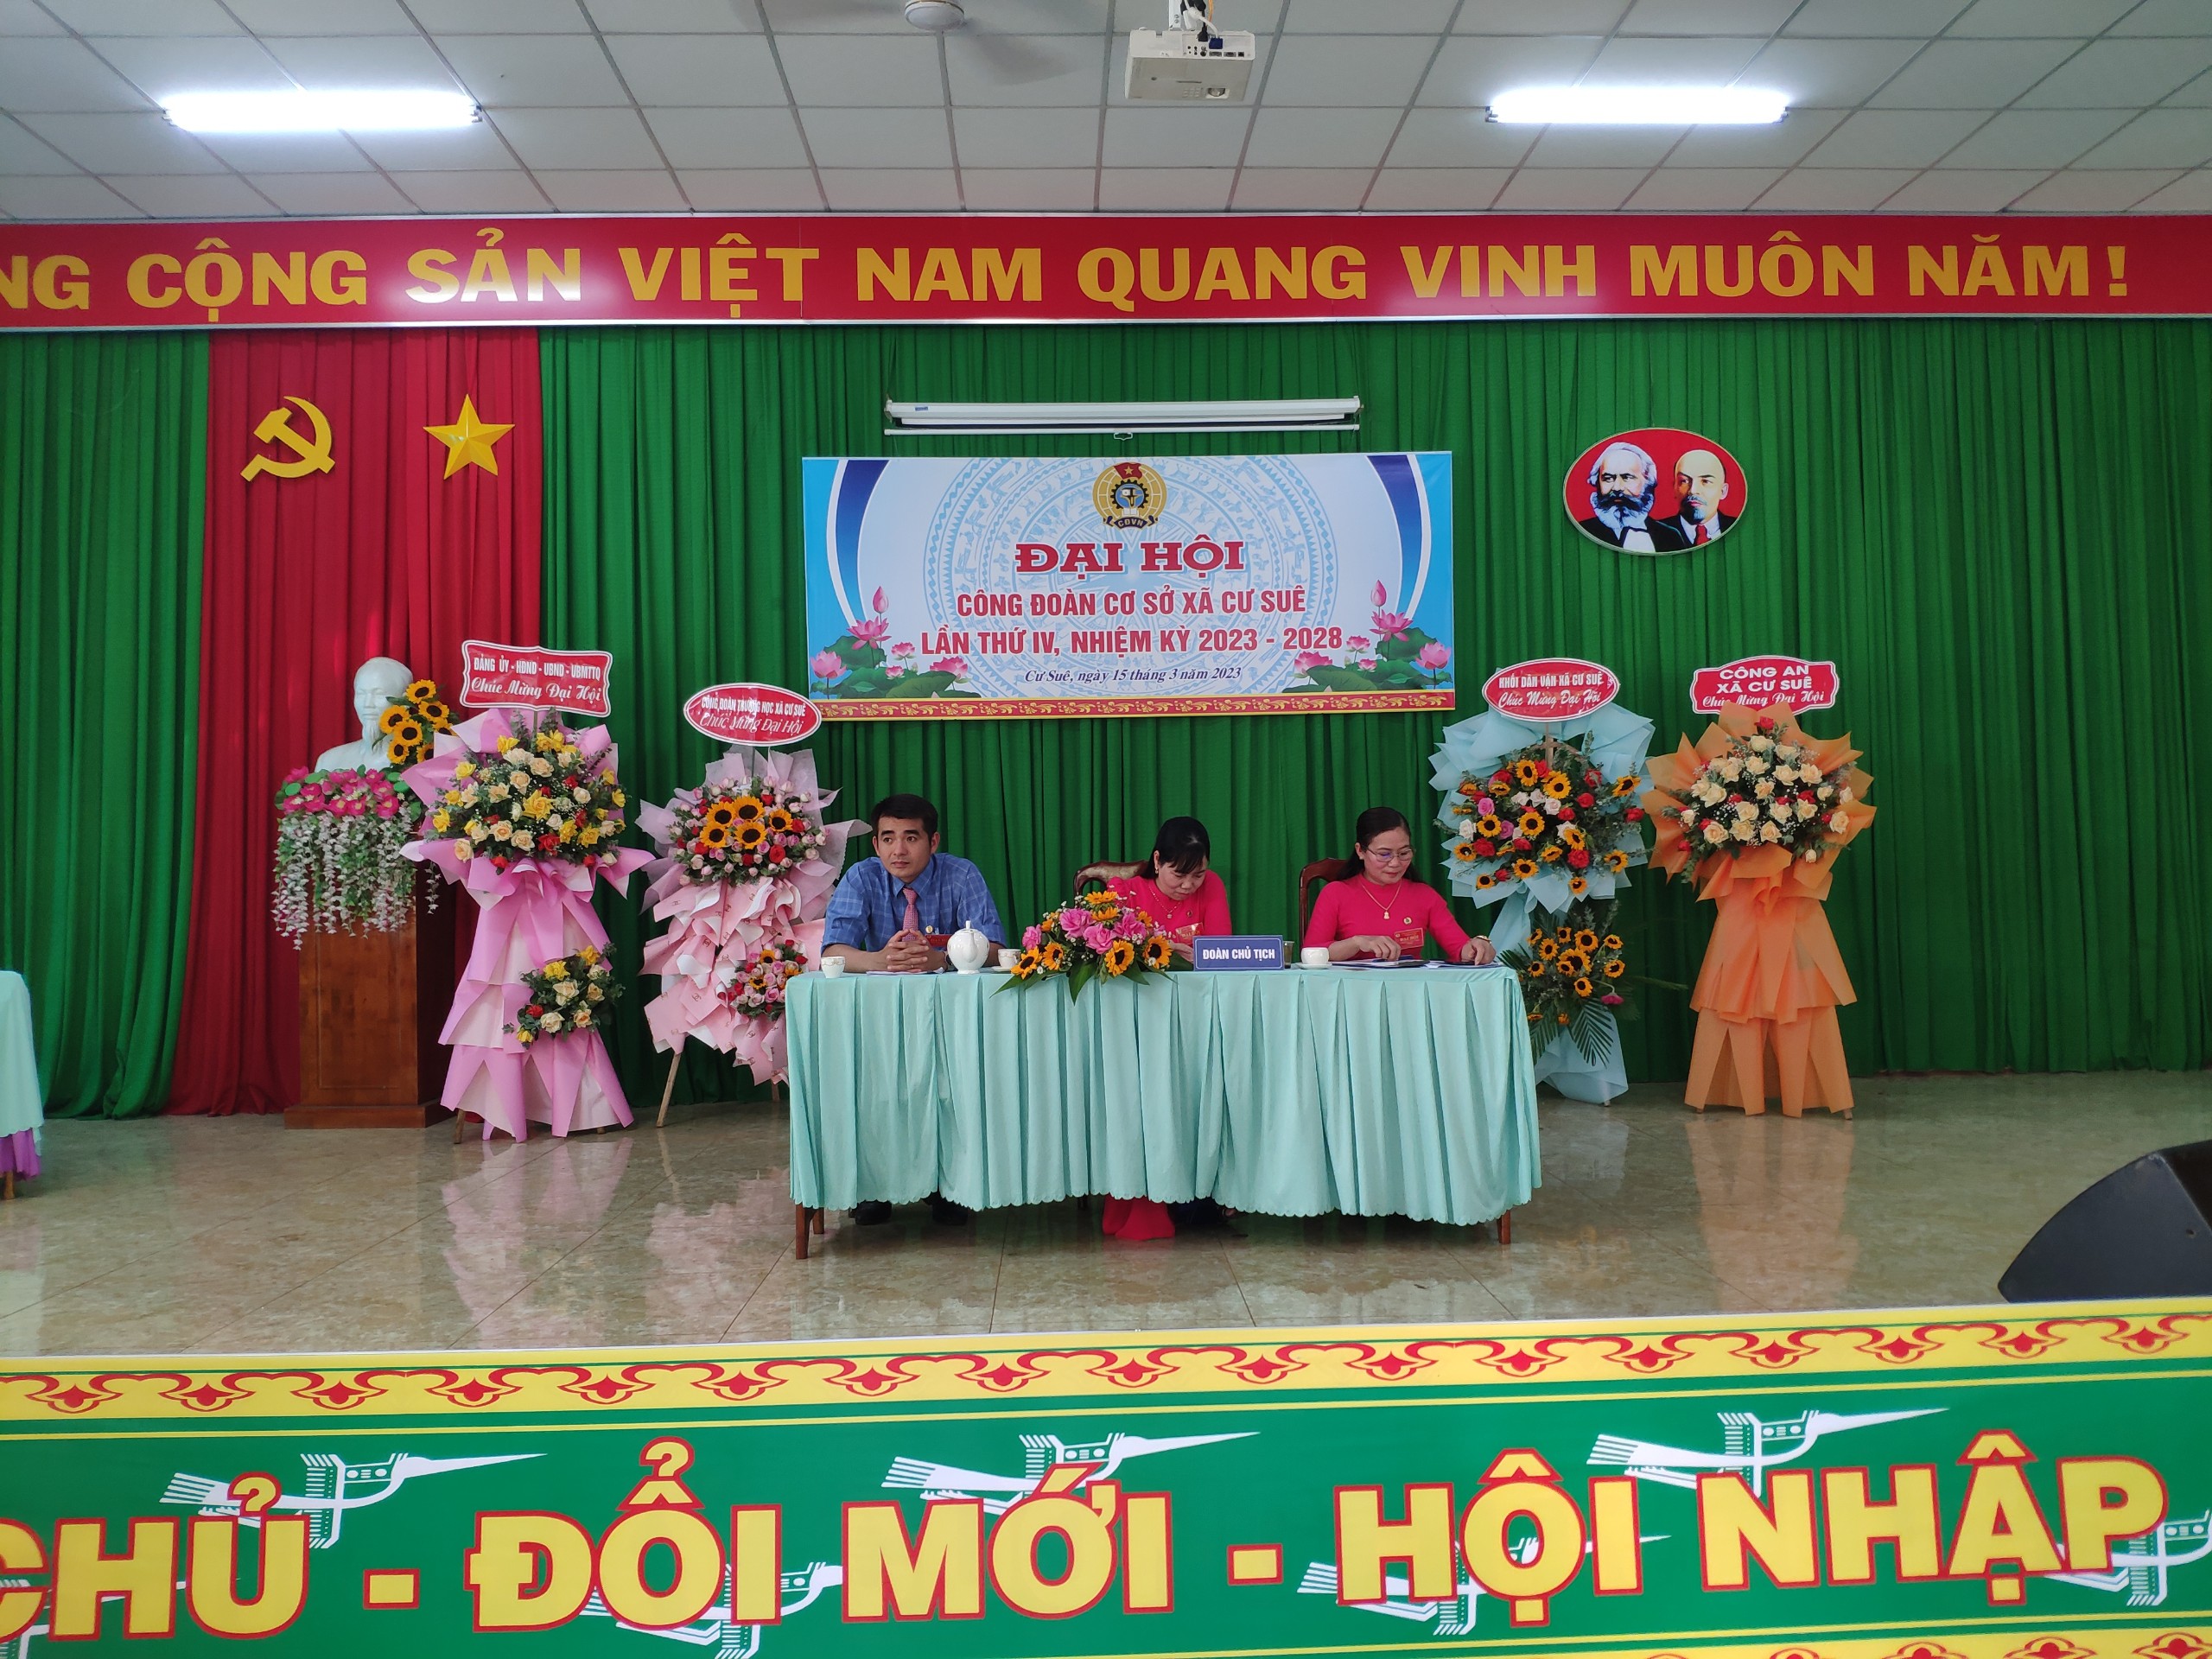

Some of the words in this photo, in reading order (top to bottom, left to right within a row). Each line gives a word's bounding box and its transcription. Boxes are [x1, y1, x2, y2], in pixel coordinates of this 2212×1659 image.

[127, 237, 367, 322] CỘNG
[404, 226, 582, 304] SẢN
[619, 232, 819, 318] VIỆT
[856, 247, 1042, 302] NAM
[1077, 245, 1366, 313] QUANG
[1401, 245, 1597, 298] VINH
[1630, 230, 1874, 297] MUÔN
[1908, 234, 2089, 296] NĂM
[1015, 543, 1123, 581] ĐẠI
[1141, 534, 1245, 578] HỘI
[957, 589, 1023, 617] CÔNG
[1030, 588, 1096, 616] ĐOÀN
[1103, 591, 1135, 615] CƠ
[1143, 585, 1174, 614] SỞ
[1183, 588, 1213, 614] XÃ
[1222, 589, 1255, 613] CƯ
[1261, 586, 1306, 613] SUÊ
[921, 625, 969, 655] LẦN
[977, 626, 1027, 654] THỨ
[1033, 631, 1060, 657] IV,
[1071, 626, 1152, 658] NHIỆM
[1160, 625, 1190, 652] KỲ
[1198, 629, 1258, 652] 2023
[1283, 626, 1343, 650] 2028
[474, 653, 496, 672] ĐẢNG
[499, 655, 510, 673] ỦY
[543, 663, 564, 677] UBND
[571, 664, 601, 681] UBMTTQ
[1025, 670, 1046, 682] Cư
[1048, 670, 1074, 683] Suê,
[1078, 669, 1109, 684] ngày
[1112, 669, 1128, 681] 15
[1130, 668, 1166, 683] tháng
[1169, 668, 1178, 680] 3
[1179, 668, 1208, 680] năm
[1211, 667, 1242, 679] 2023
[1719, 666, 1777, 680] CÔNG
[1783, 664, 1809, 677] AN
[471, 677, 503, 694] Chúc
[505, 680, 543, 700] Mừng
[546, 683, 573, 702] Đại
[576, 685, 601, 704] Hội
[1499, 672, 1519, 689] KHỐI
[1521, 674, 1538, 688] DÂN
[1541, 673, 1557, 690] VẬN
[1559, 672, 1570, 687] XÃ
[1573, 673, 1585, 686] CƯ
[1586, 671, 1603, 685] SUÊ
[1716, 680, 1742, 694] XÃ
[1748, 679, 1776, 692] CƯ
[1780, 676, 1813, 690] SUÊ
[702, 695, 718, 709] CÔNG
[761, 701, 774, 716] HỌC
[775, 701, 784, 715] XÃ
[794, 702, 806, 717] SUÊ
[1498, 691, 1523, 709] Chúc
[1560, 690, 1581, 708] Đại
[1583, 689, 1602, 707] Hội
[1702, 696, 1731, 708] Chú
[1801, 690, 1825, 704] Hội
[761, 718, 784, 735] Đại
[781, 719, 804, 736] Hội
[1203, 947, 1230, 960] ĐOÀN
[1231, 945, 1251, 960] CHỦ
[1253, 949, 1275, 962] TỊCH
[463, 1436, 782, 1632] ĐỔI
[842, 1461, 1174, 1623] MỚI
[1333, 1447, 1643, 1628] HỘI
[1695, 1429, 2169, 1606] NHẬP
